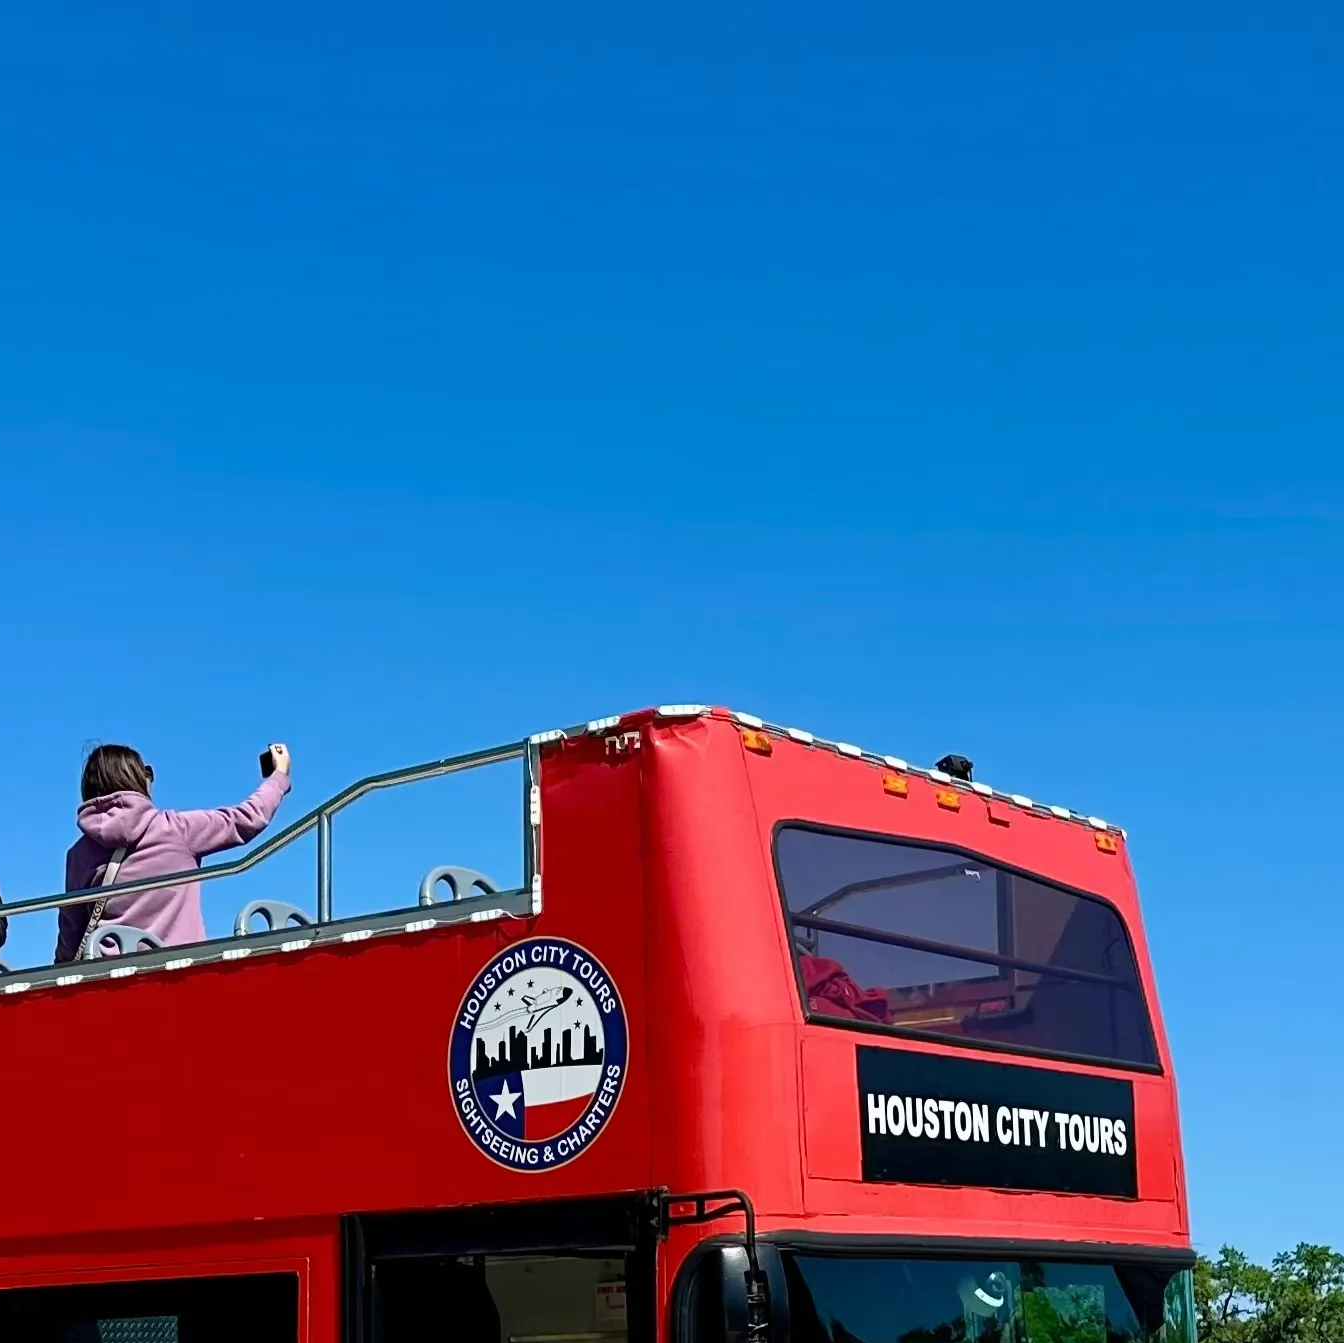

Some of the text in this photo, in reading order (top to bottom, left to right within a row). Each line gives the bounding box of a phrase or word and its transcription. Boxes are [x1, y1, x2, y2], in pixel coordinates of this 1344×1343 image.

[460, 946, 616, 1029] HOUSTON CITY TOURS
[456, 1064, 621, 1166] SIGHTSEEING & CHARTERS
[867, 1093, 1127, 1156] HOUSTON CITY TOURS
